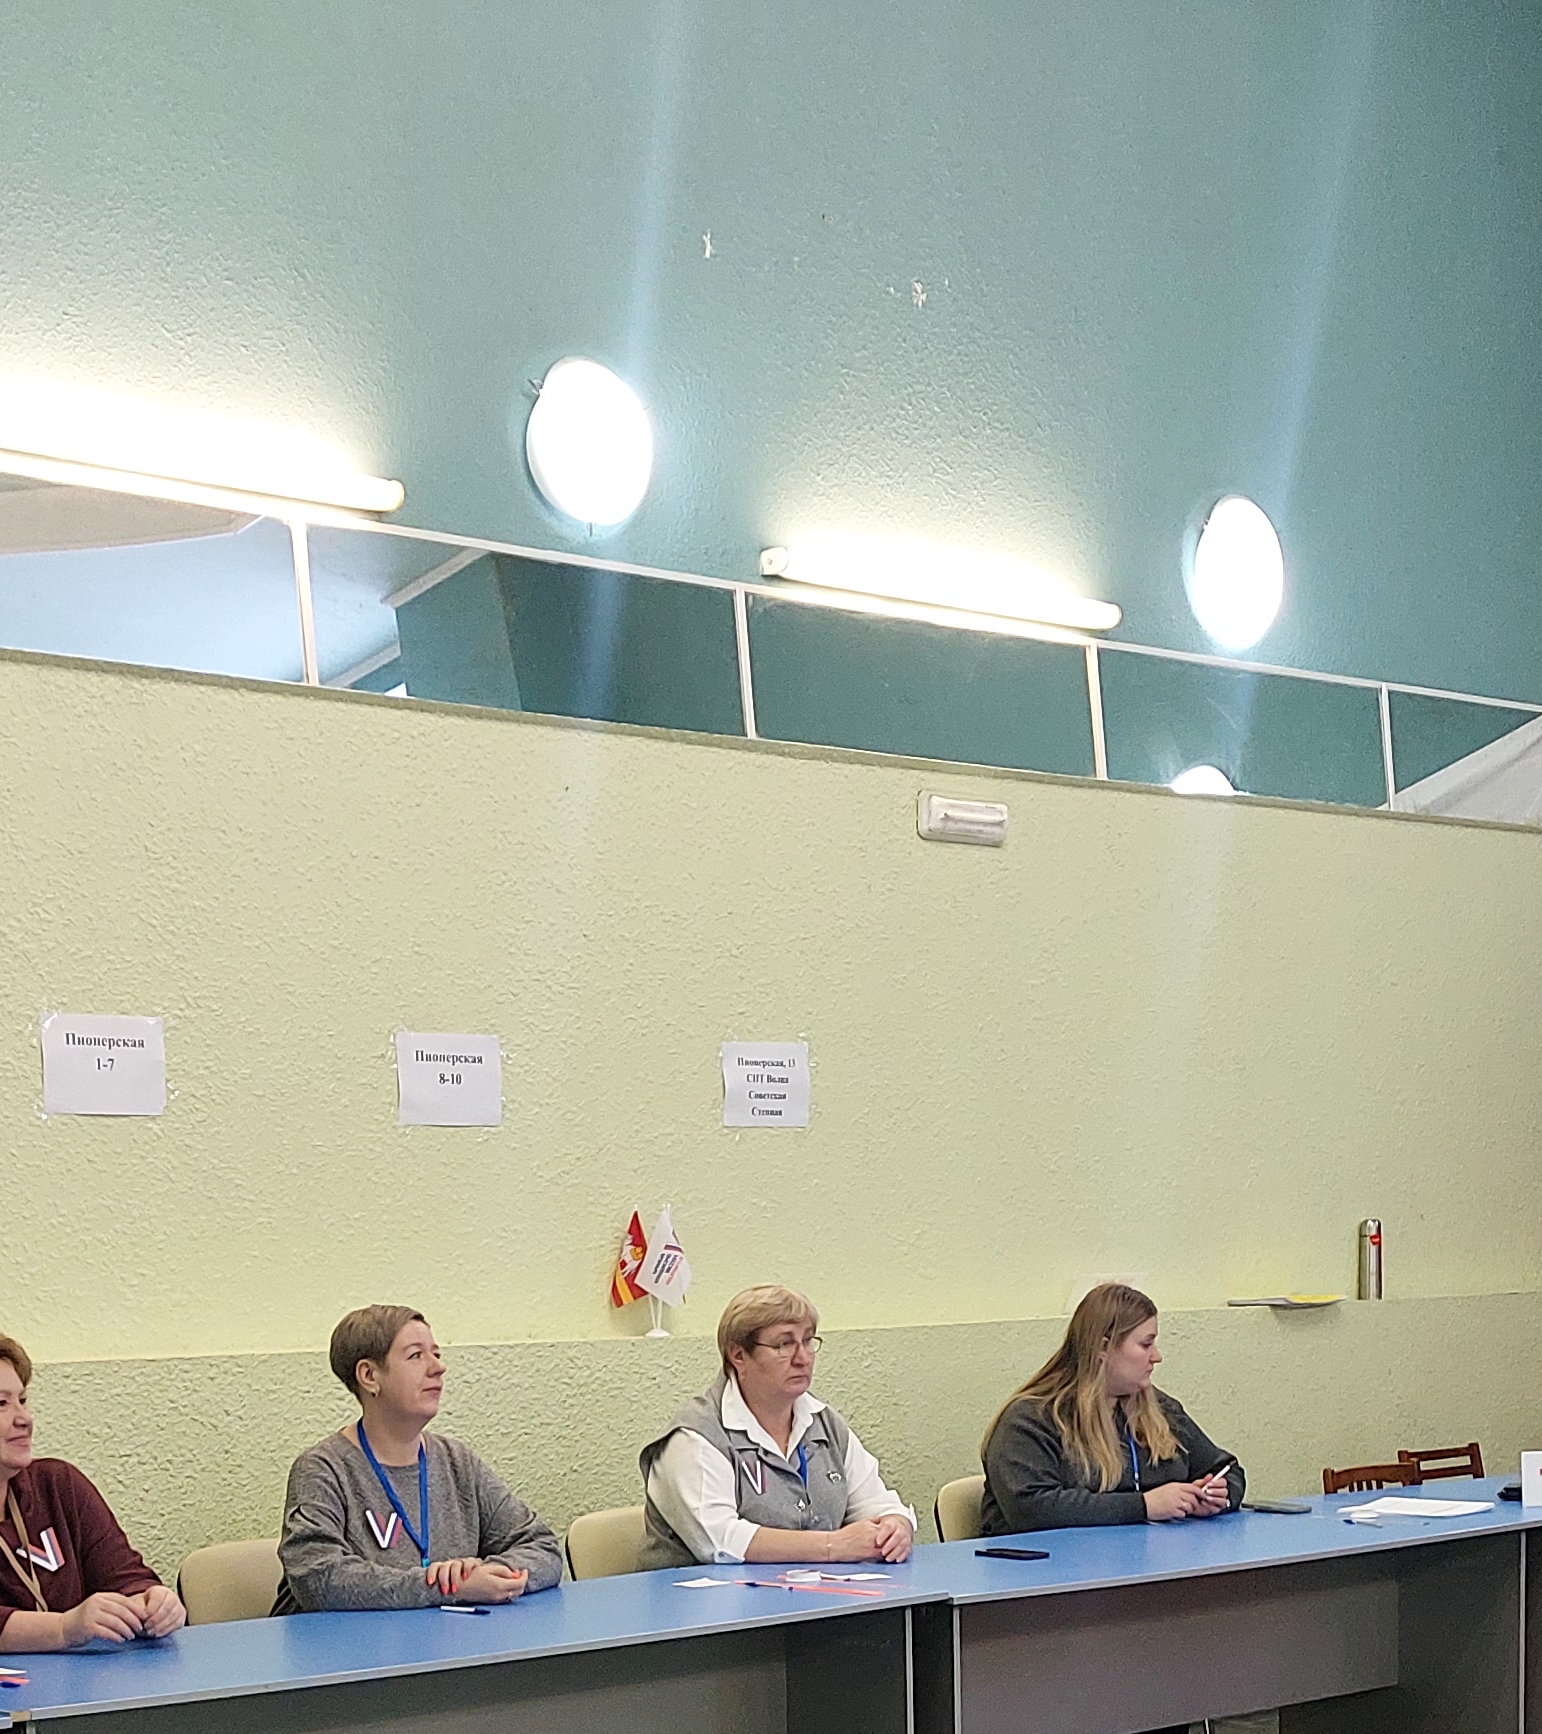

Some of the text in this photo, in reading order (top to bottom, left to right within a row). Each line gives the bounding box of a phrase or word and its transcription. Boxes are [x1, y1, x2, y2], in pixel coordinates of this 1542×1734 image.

[65, 1032, 145, 1051] Пионерская
[96, 1057, 115, 1071] 1-7
[415, 1049, 484, 1067] Пионерская
[438, 1072, 463, 1086] 8-10
